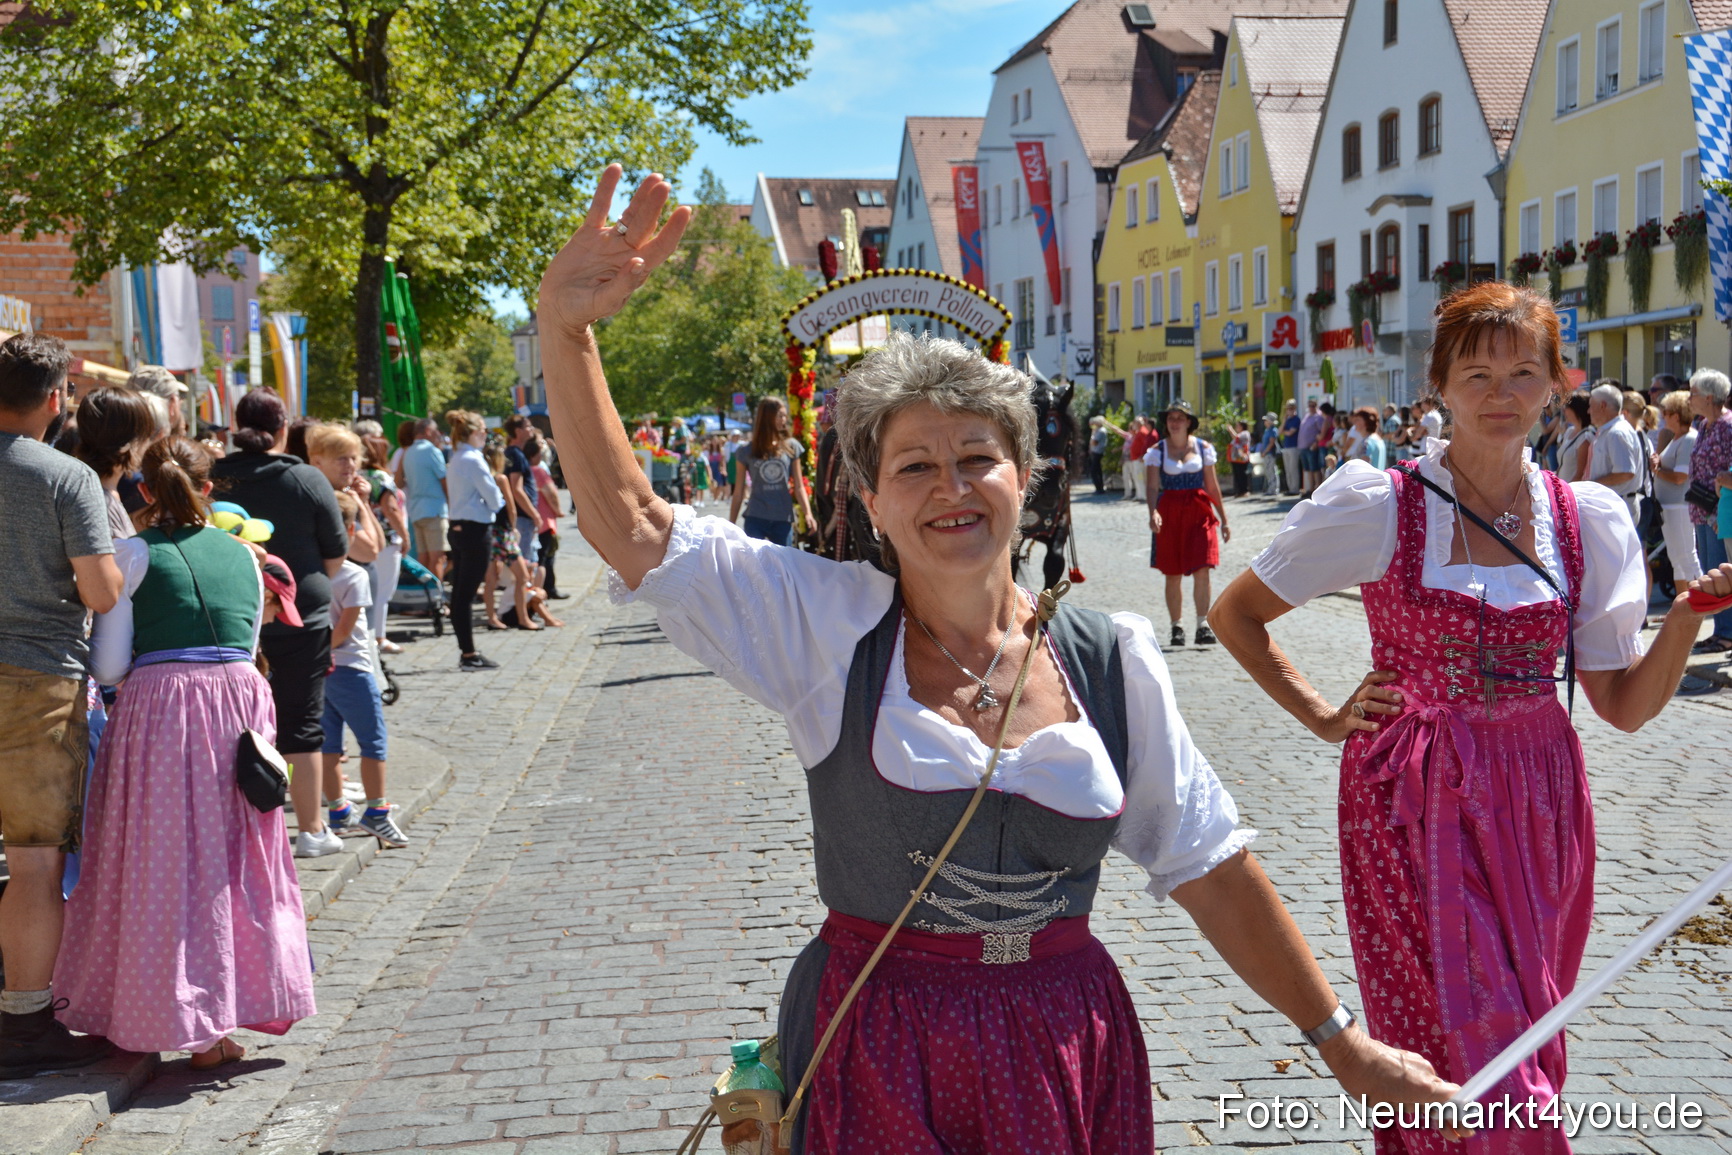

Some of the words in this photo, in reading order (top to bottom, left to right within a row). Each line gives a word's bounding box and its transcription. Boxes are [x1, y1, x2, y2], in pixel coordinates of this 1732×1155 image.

[1023, 145, 1044, 182] K&L
[1138, 246, 1161, 270] HOTEL
[799, 281, 929, 337] Gesangverein
[937, 287, 995, 336] Pölling
[1137, 351, 1168, 364] Restaurant
